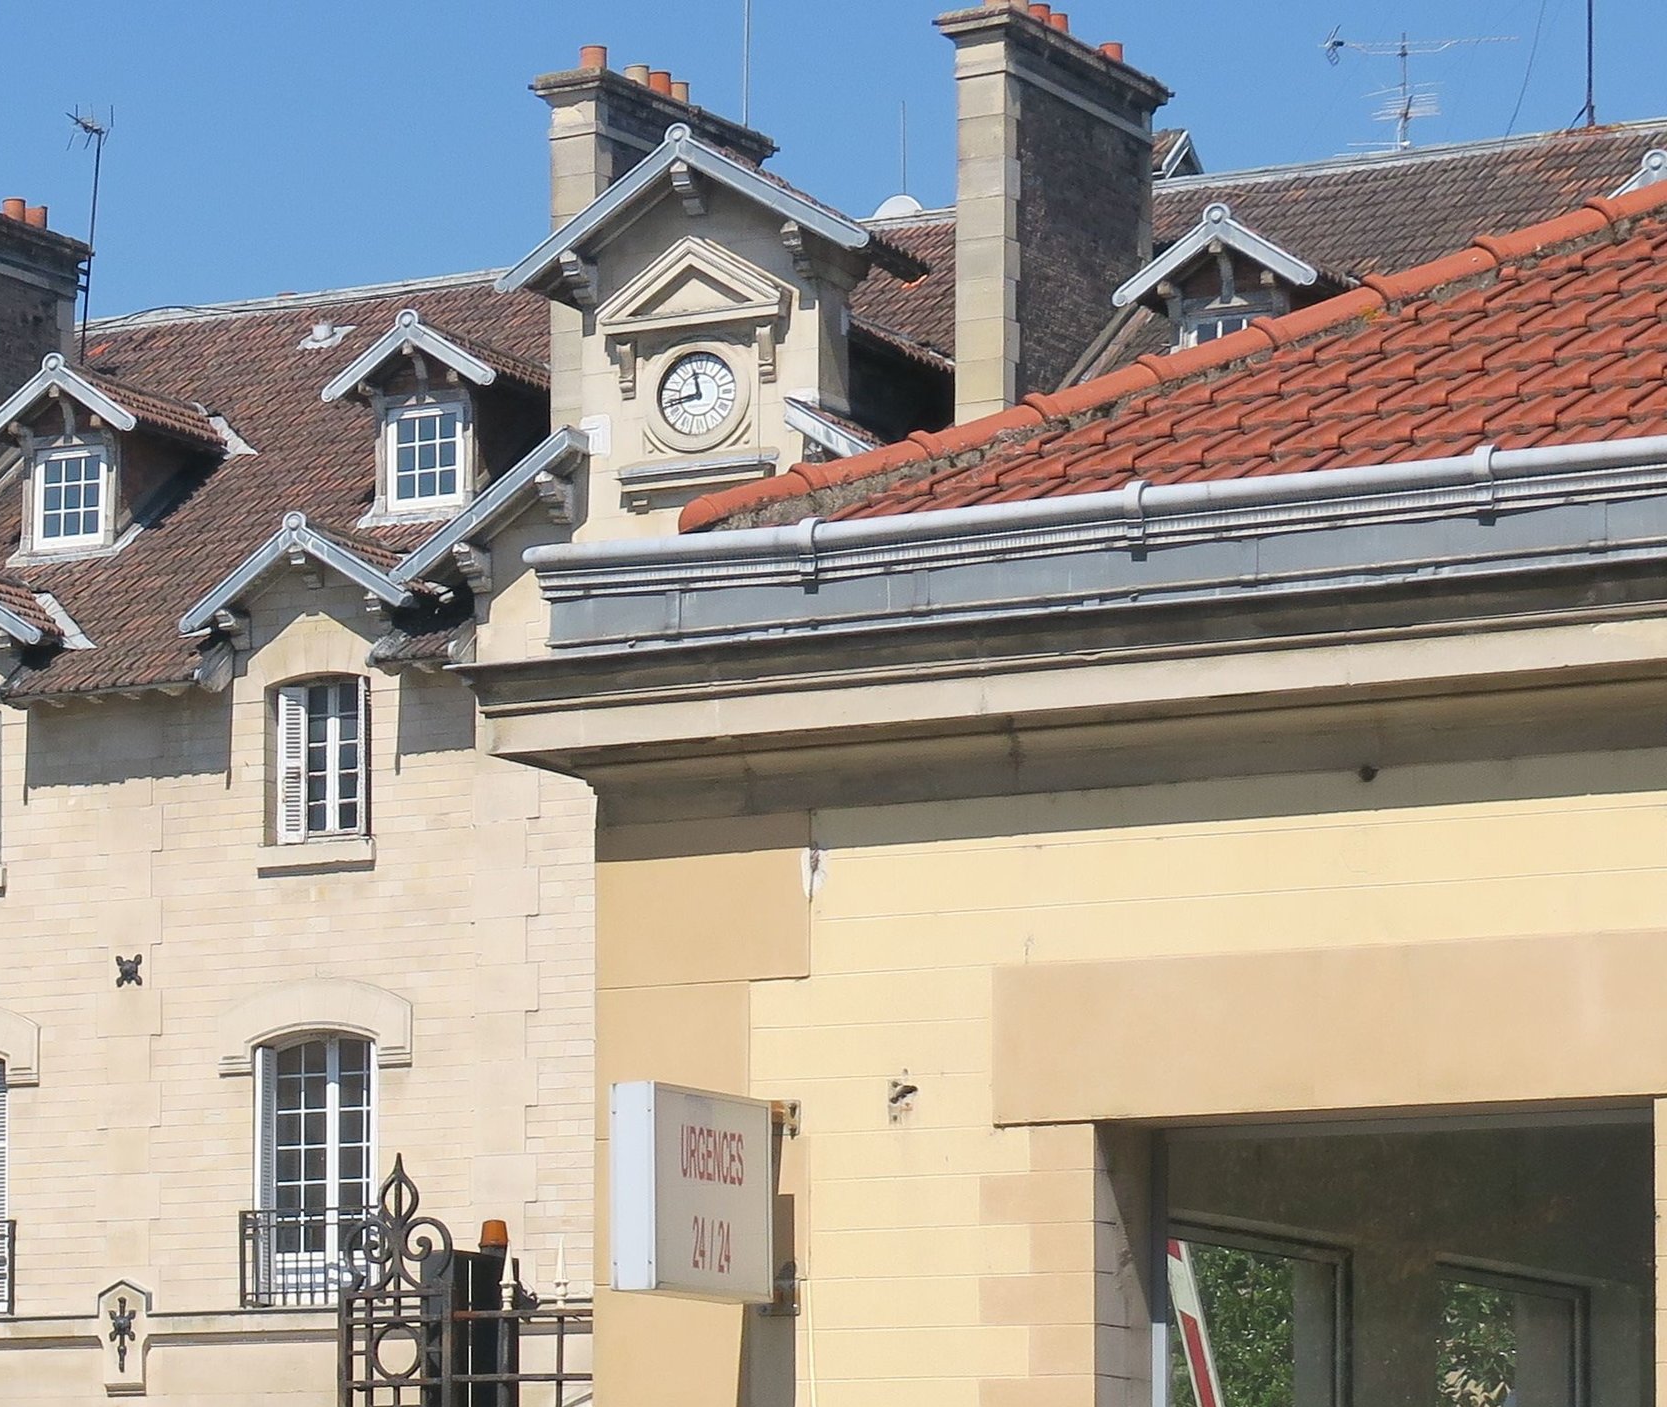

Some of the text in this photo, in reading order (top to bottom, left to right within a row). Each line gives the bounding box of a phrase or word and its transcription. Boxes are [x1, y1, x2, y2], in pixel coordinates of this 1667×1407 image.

[681, 1124, 744, 1186] URGENCES
[692, 1215, 705, 1270] 24
[718, 1220, 731, 1274] 24
